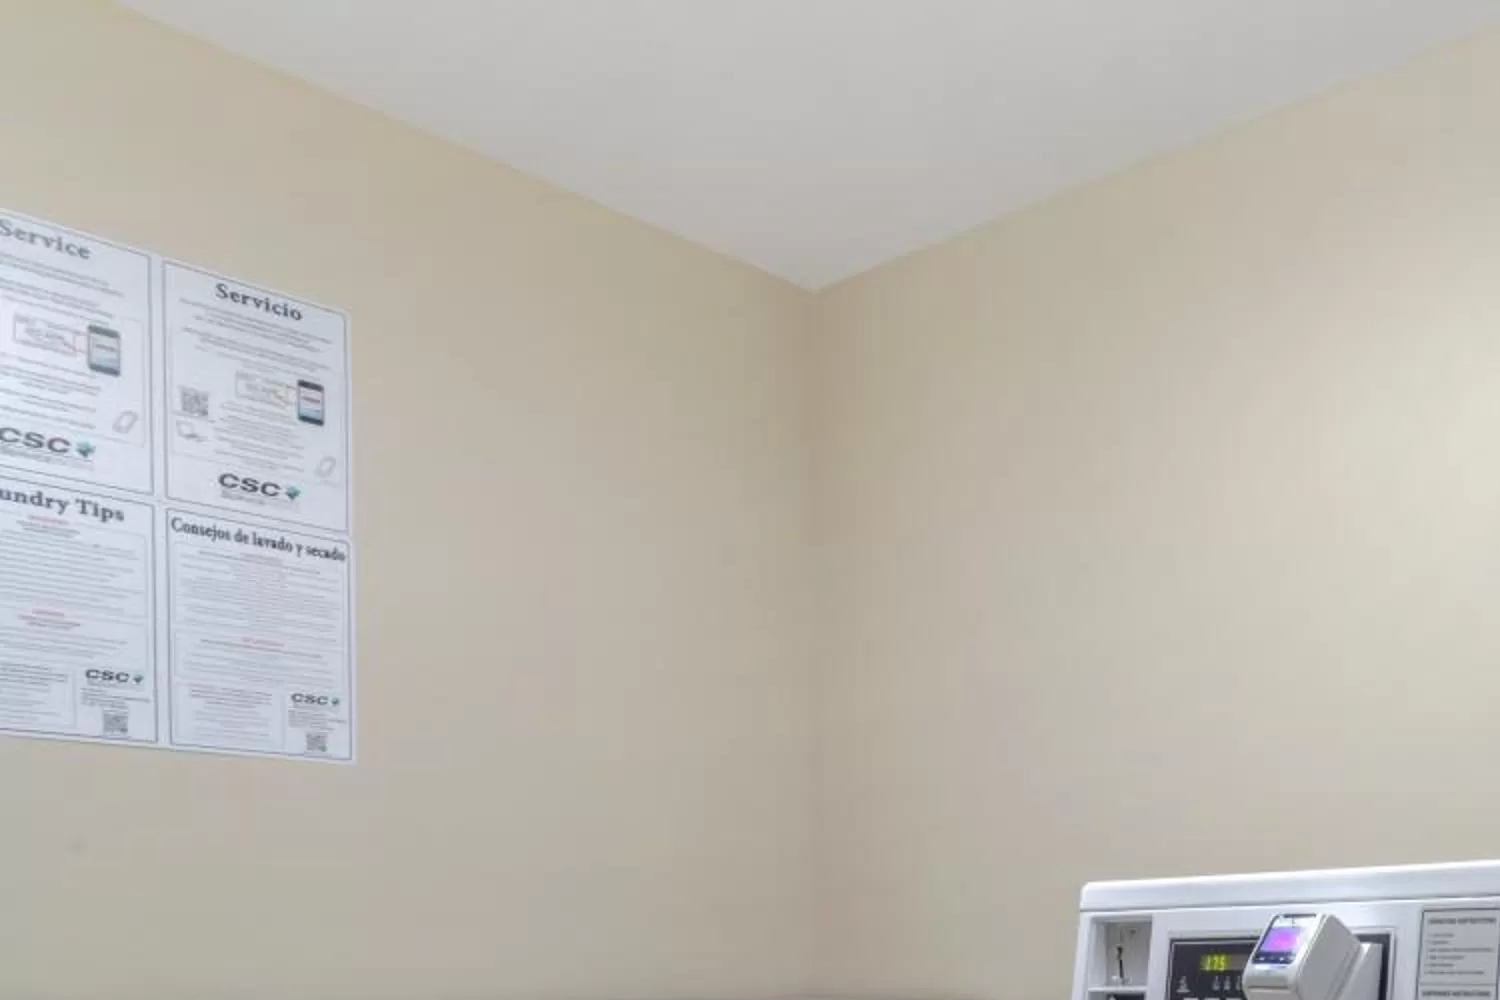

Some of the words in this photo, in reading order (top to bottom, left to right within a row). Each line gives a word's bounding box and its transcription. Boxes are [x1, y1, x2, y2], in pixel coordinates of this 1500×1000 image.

[0, 219, 91, 260] Service
[215, 283, 303, 321] Servicio
[0, 427, 72, 453] CSC
[218, 473, 282, 497] CSC
[75, 498, 125, 522] Tips
[171, 517, 231, 542] Consejos
[234, 528, 250, 544] de
[252, 532, 293, 553] lavado
[86, 669, 130, 683] CSC
